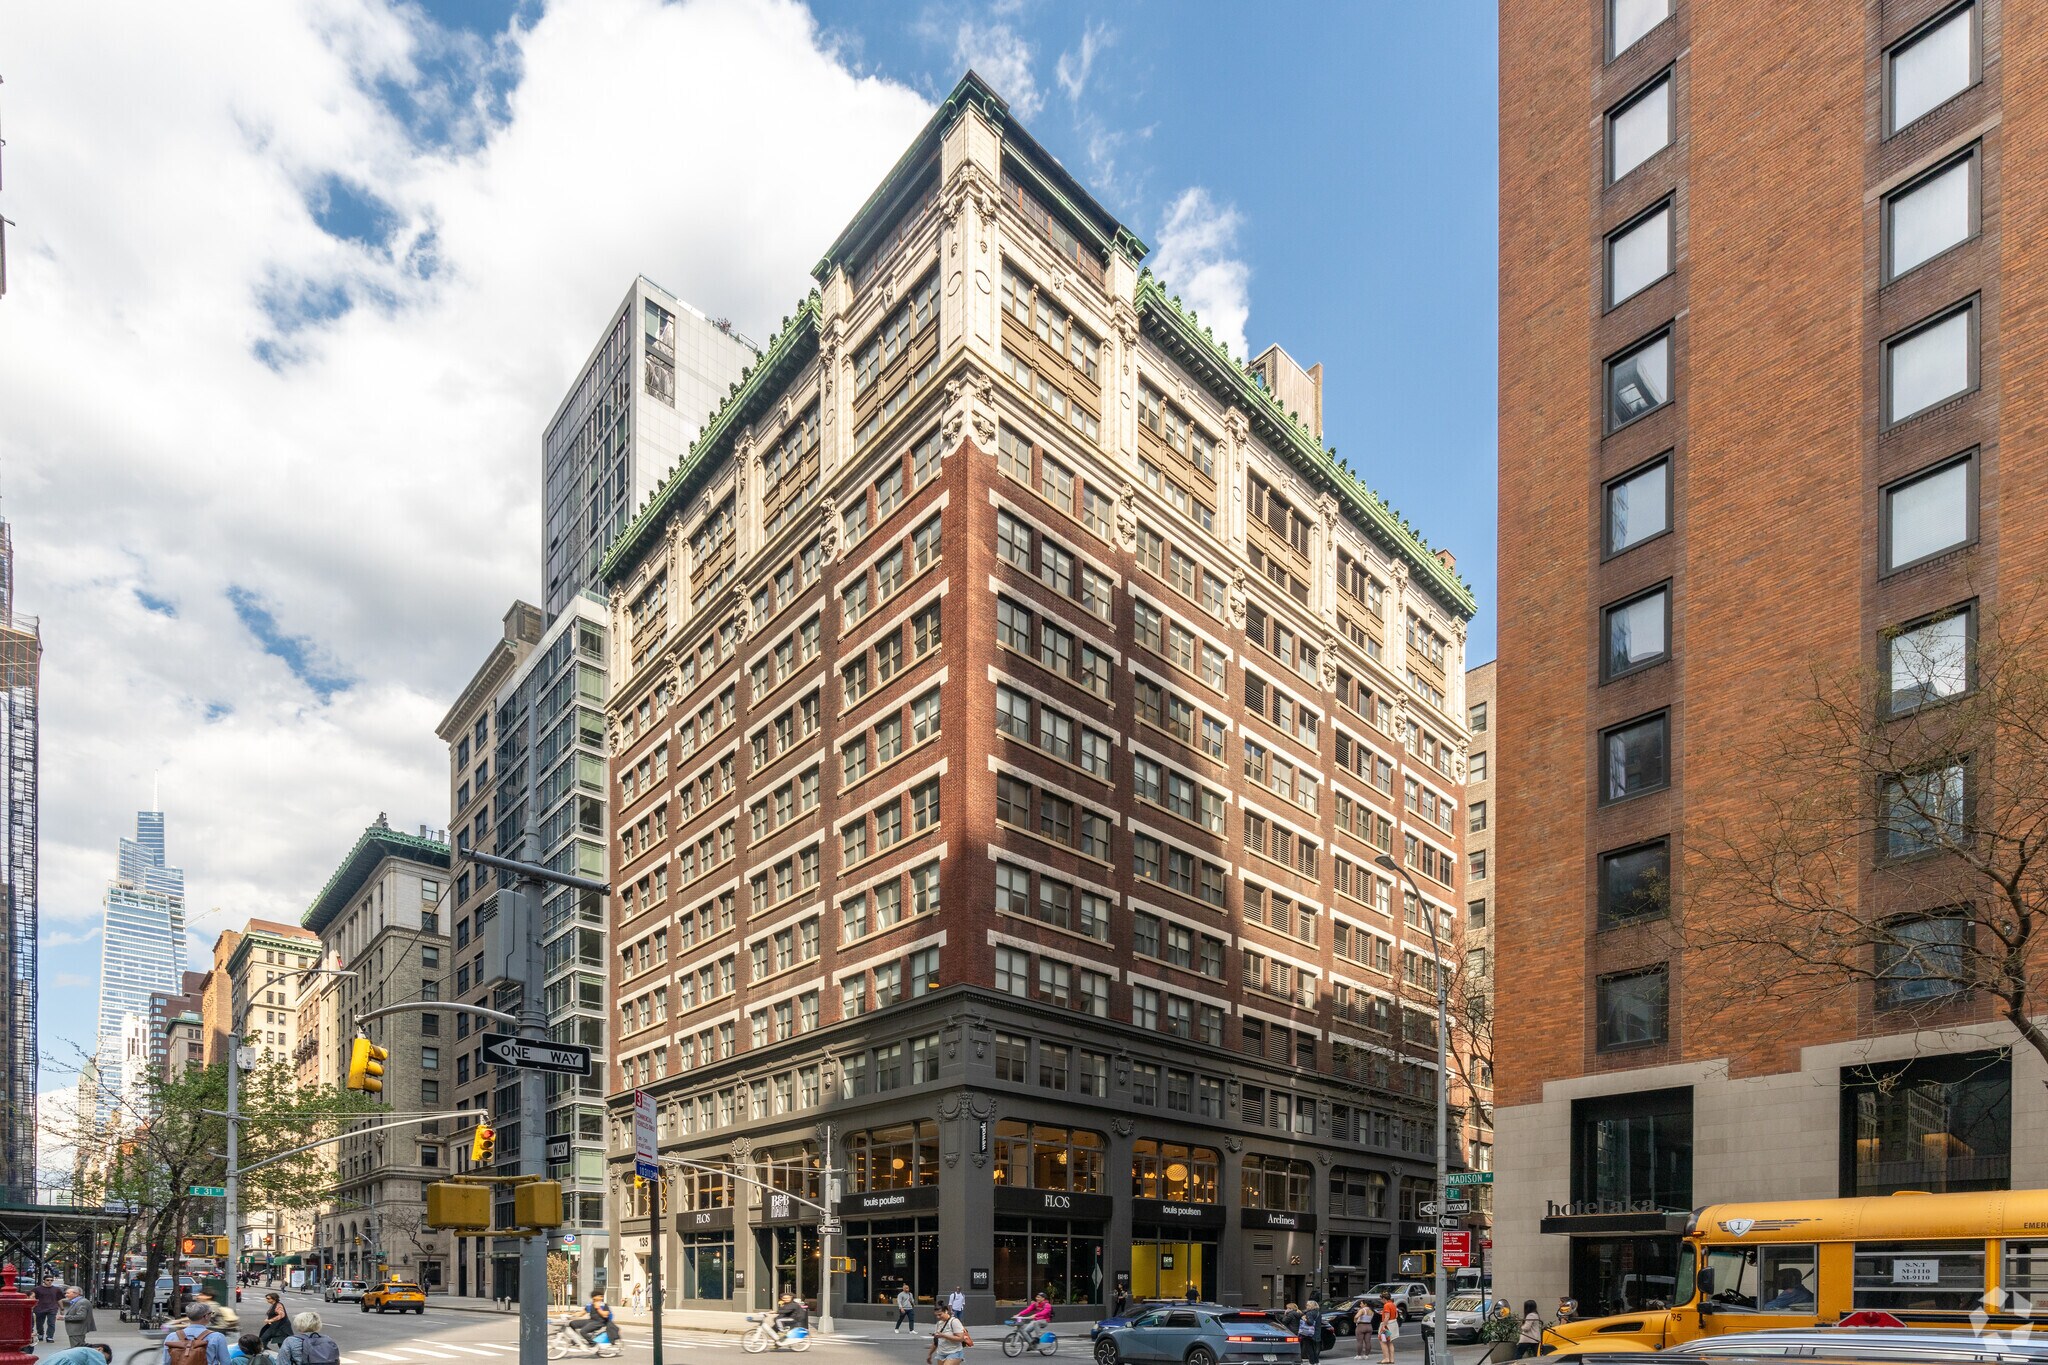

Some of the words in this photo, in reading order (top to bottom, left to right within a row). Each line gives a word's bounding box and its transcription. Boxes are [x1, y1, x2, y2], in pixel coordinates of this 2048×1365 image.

[501, 1044, 530, 1059] ONE
[550, 1051, 579, 1065] WAY
[637, 1092, 642, 1106] 3
[553, 1143, 566, 1156] WAY
[1449, 1174, 1483, 1184] MADISON
[203, 1187, 212, 1195] 31
[771, 1194, 790, 1207] B&B
[863, 1198, 878, 1207] louis
[879, 1195, 905, 1208] poulsen
[1045, 1194, 1070, 1209] FLOS
[1162, 1205, 1177, 1214] louis
[1178, 1206, 1202, 1216] poulsen
[1426, 1205, 1437, 1213] ON
[1449, 1203, 1467, 1212] WAY
[1546, 1198, 1603, 1217] hotel
[696, 1213, 711, 1224] FLOS
[1267, 1213, 1295, 1225] Arclinea
